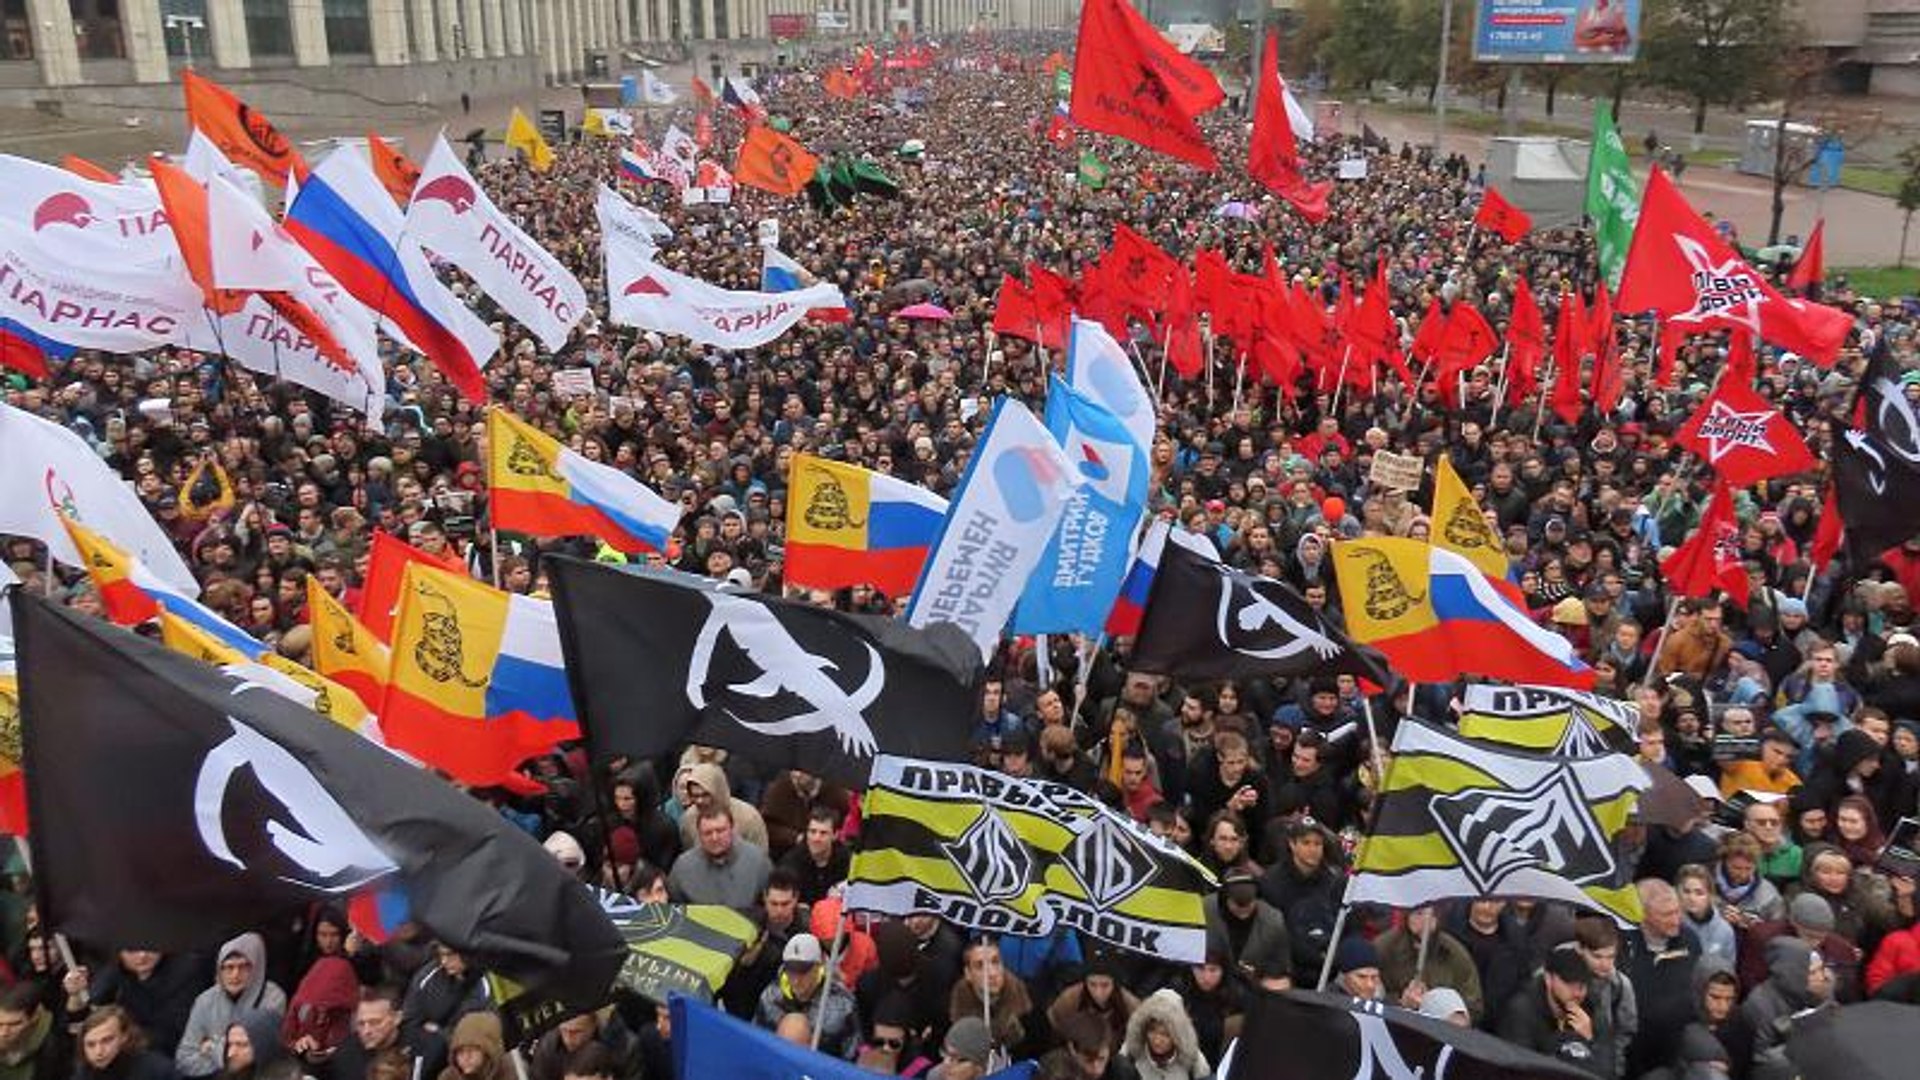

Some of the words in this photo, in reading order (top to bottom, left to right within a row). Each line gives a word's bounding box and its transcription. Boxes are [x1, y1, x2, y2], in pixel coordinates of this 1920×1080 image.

[0, 263, 176, 334] ПАРНАС
[479, 222, 572, 324] ПАРНАС
[703, 301, 796, 332] АРНА
[1053, 489, 1091, 588] ДМИТРИЙ
[1074, 510, 1109, 586] ГУДКОВ
[914, 888, 1043, 935] БЛОК
[1047, 899, 1160, 953] БЛОК
